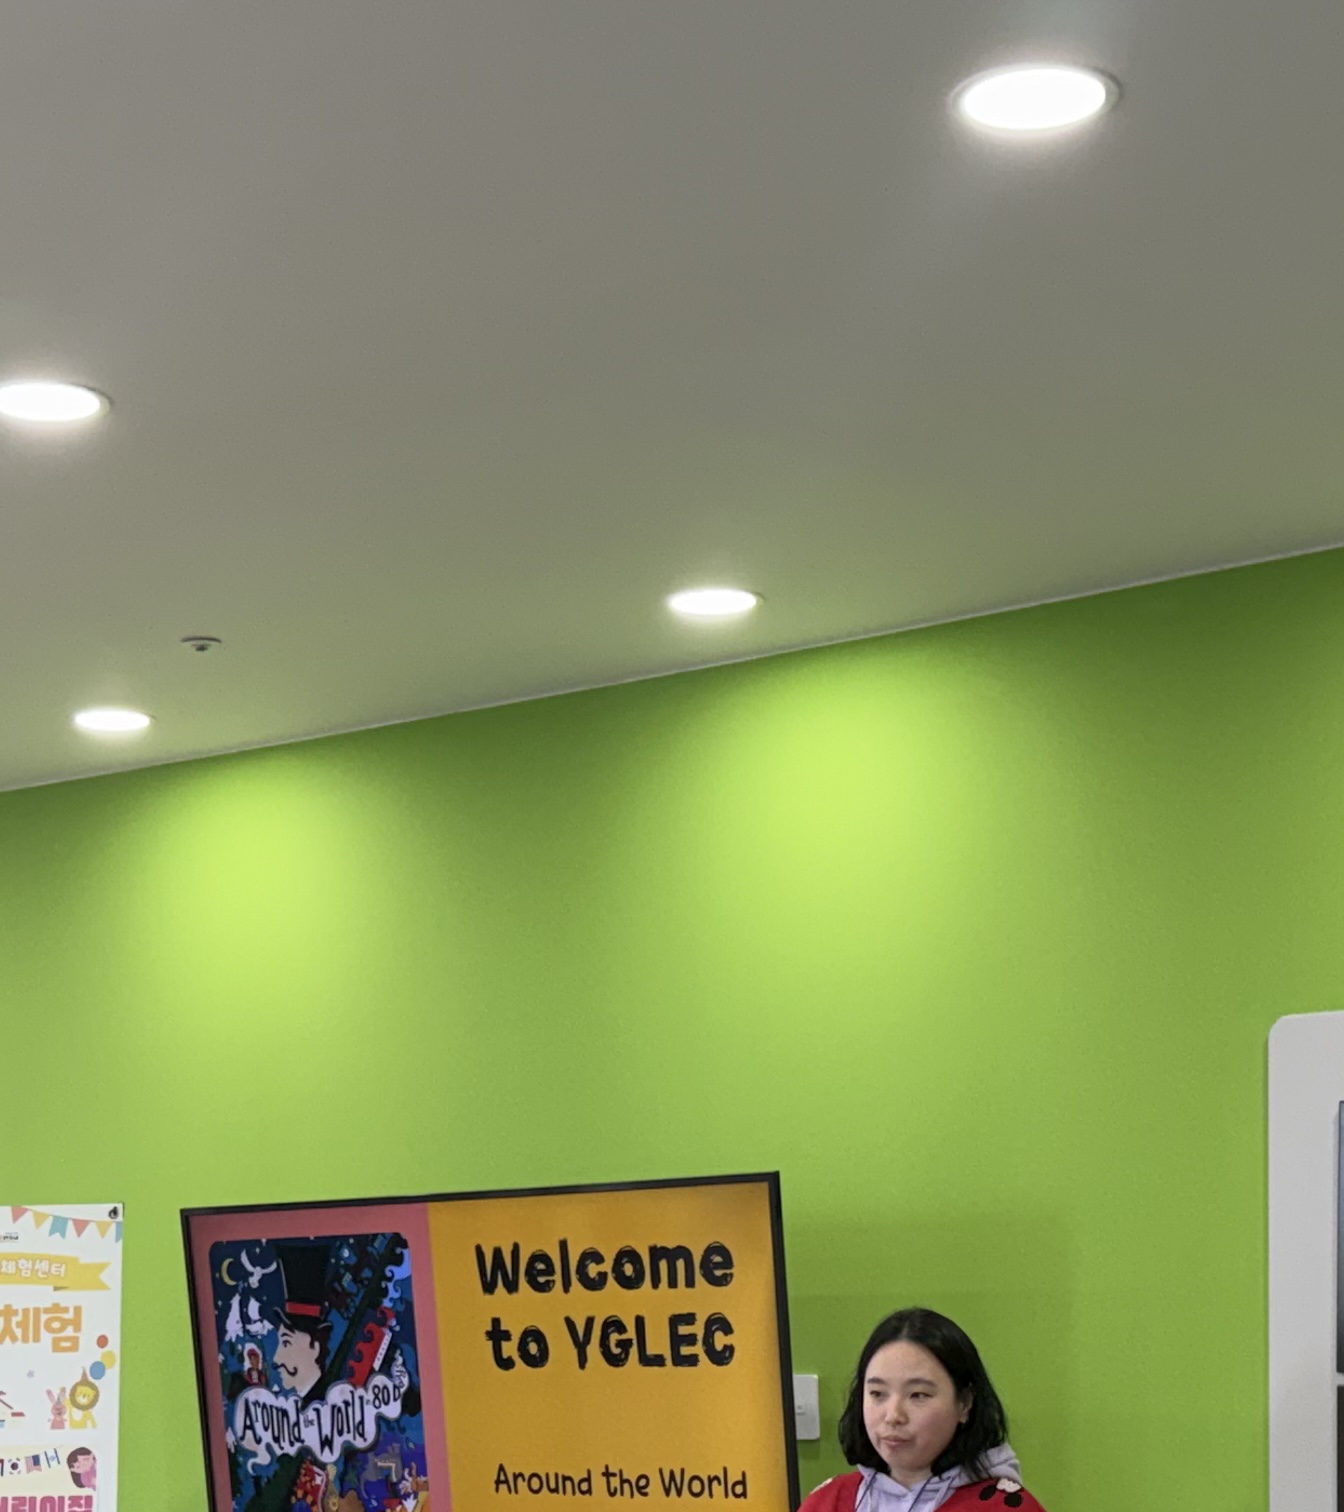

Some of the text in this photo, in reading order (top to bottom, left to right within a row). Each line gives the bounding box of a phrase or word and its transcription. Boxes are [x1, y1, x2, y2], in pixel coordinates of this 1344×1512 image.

[475, 1237, 735, 1295] Welcome
[484, 1311, 736, 1371] to YGLEC
[240, 1398, 306, 1451] Around
[313, 1390, 367, 1457] World
[372, 1383, 390, 1409] 80
[494, 1463, 749, 1500] Around the World
